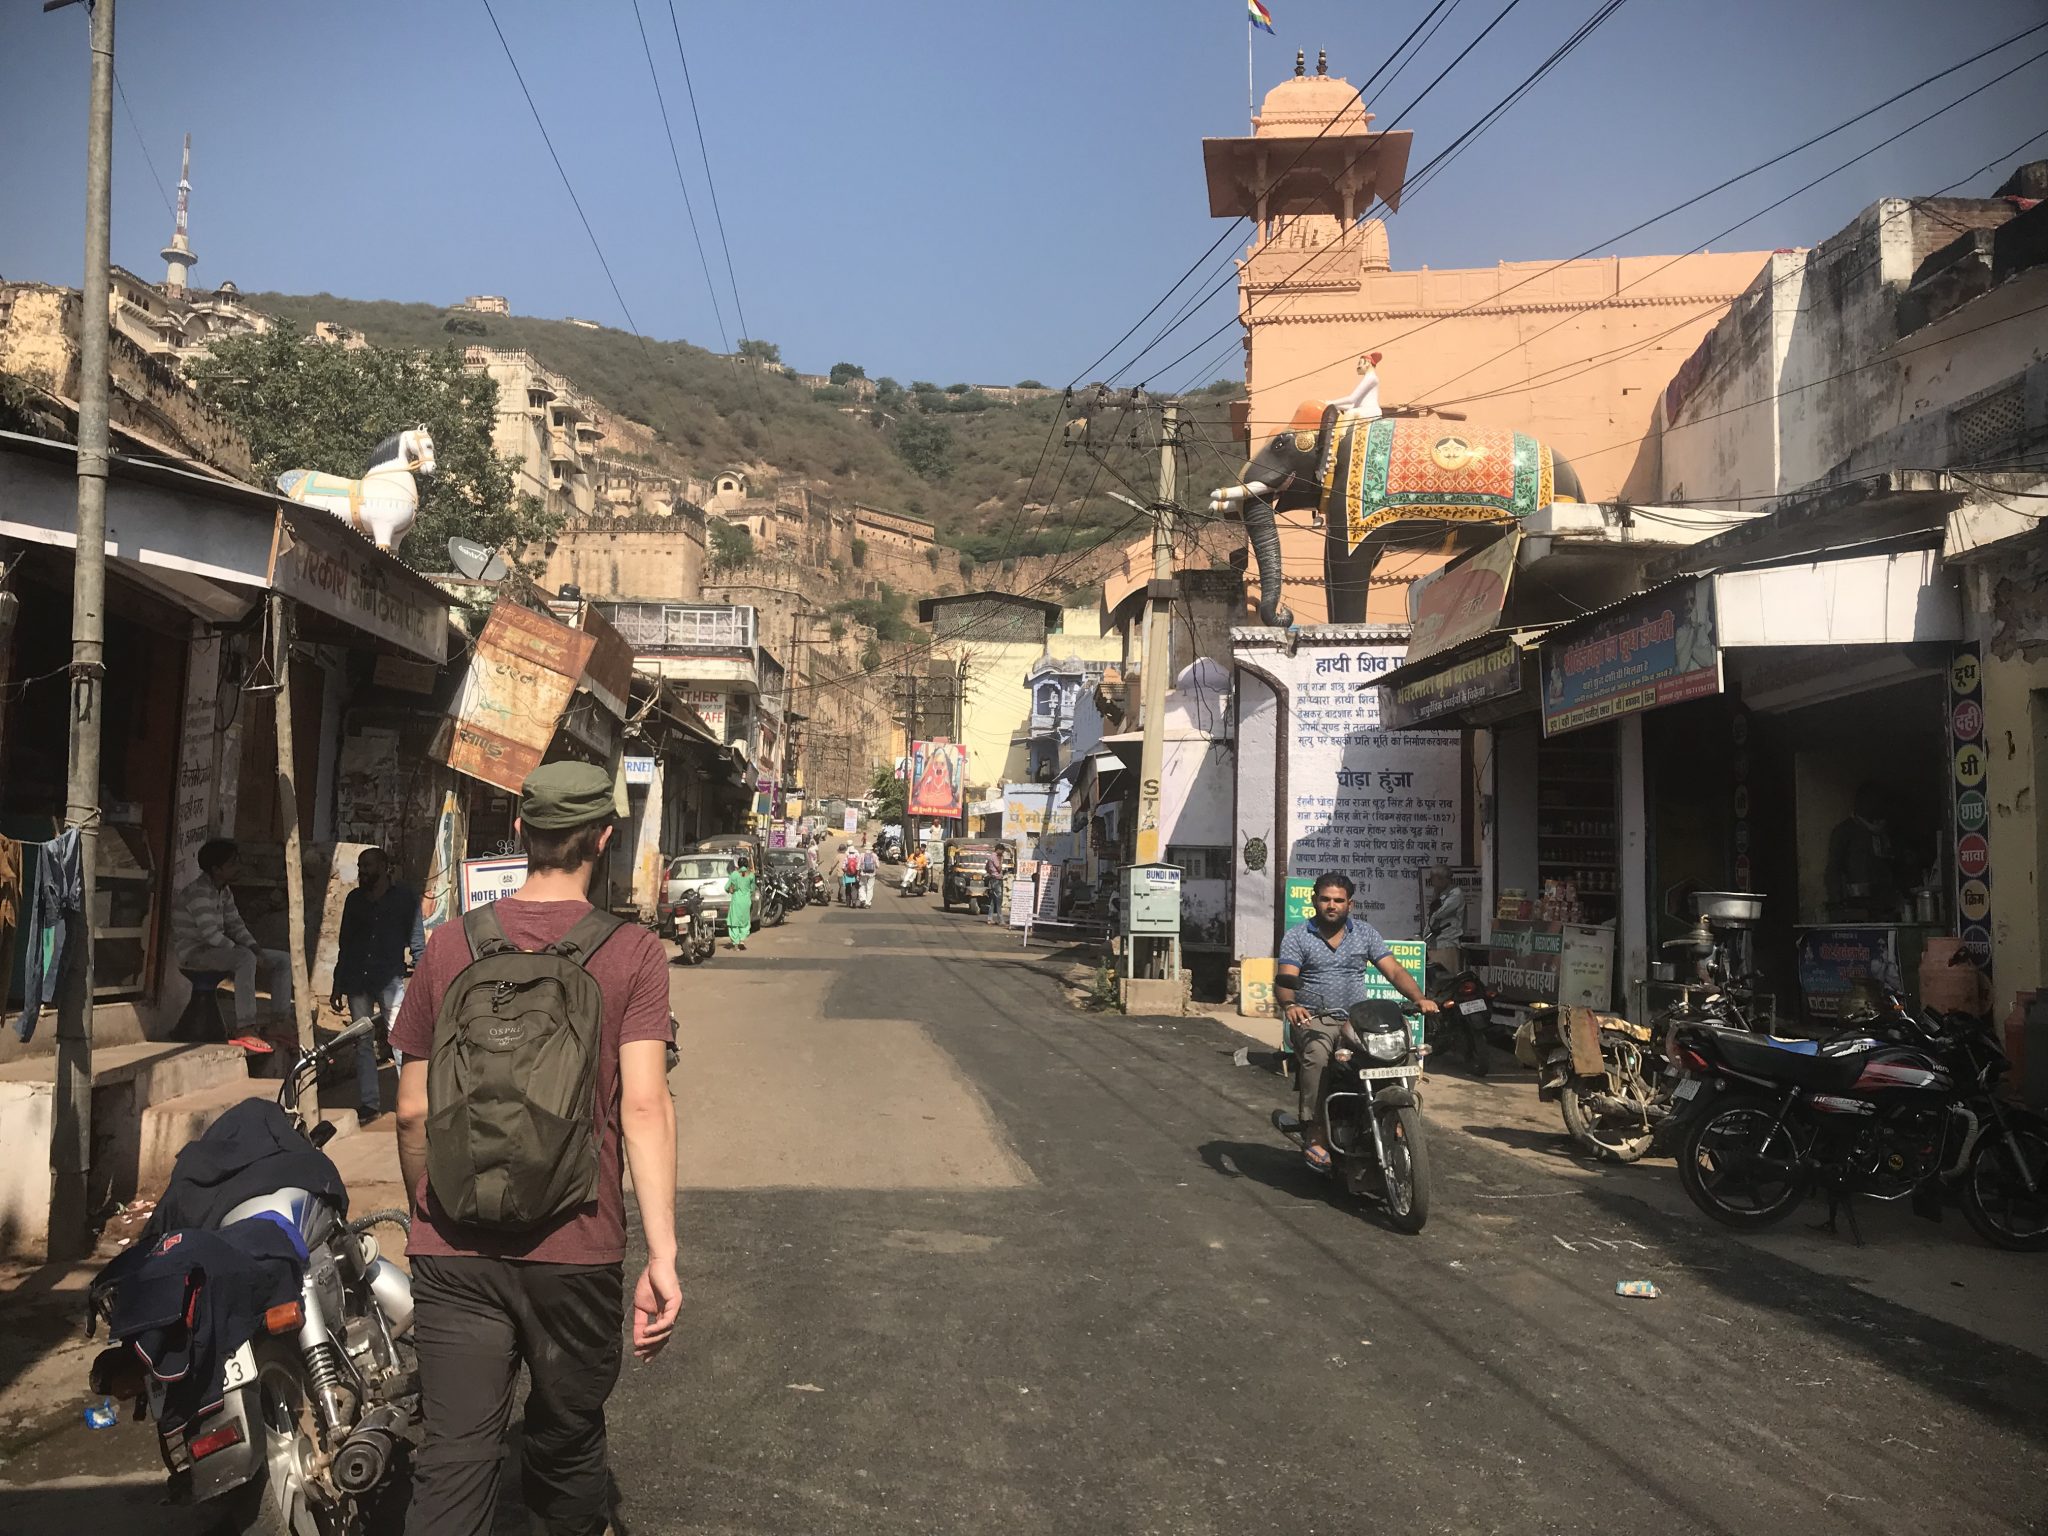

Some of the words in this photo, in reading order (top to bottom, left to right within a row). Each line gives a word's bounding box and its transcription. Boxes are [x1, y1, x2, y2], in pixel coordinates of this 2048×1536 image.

[1316, 653, 1352, 676] हाथी
[1356, 652, 1388, 673] शिव
[1954, 665, 1976, 688] दूध
[1356, 706, 1365, 718] भी
[1956, 706, 1979, 731] दही
[1317, 736, 1327, 746] पर
[1354, 733, 1370, 746] प्रति
[1373, 733, 1388, 748] मूर्ति
[1391, 736, 1401, 746] का
[626, 760, 652, 772] RNET
[1960, 754, 1979, 777] घी
[1335, 766, 1372, 790] घोड़ा
[1337, 798, 1350, 807] राव
[1352, 798, 1371, 807] राजा
[1961, 802, 1983, 820] छाछ
[1333, 826, 1344, 834] पर
[1961, 849, 1985, 862] मावा
[1146, 870, 1167, 880] BUNDI
[1168, 870, 1180, 880] INN
[471, 890, 498, 902] HOTEL
[1489, 958, 1525, 993] आयुर्वेदिक
